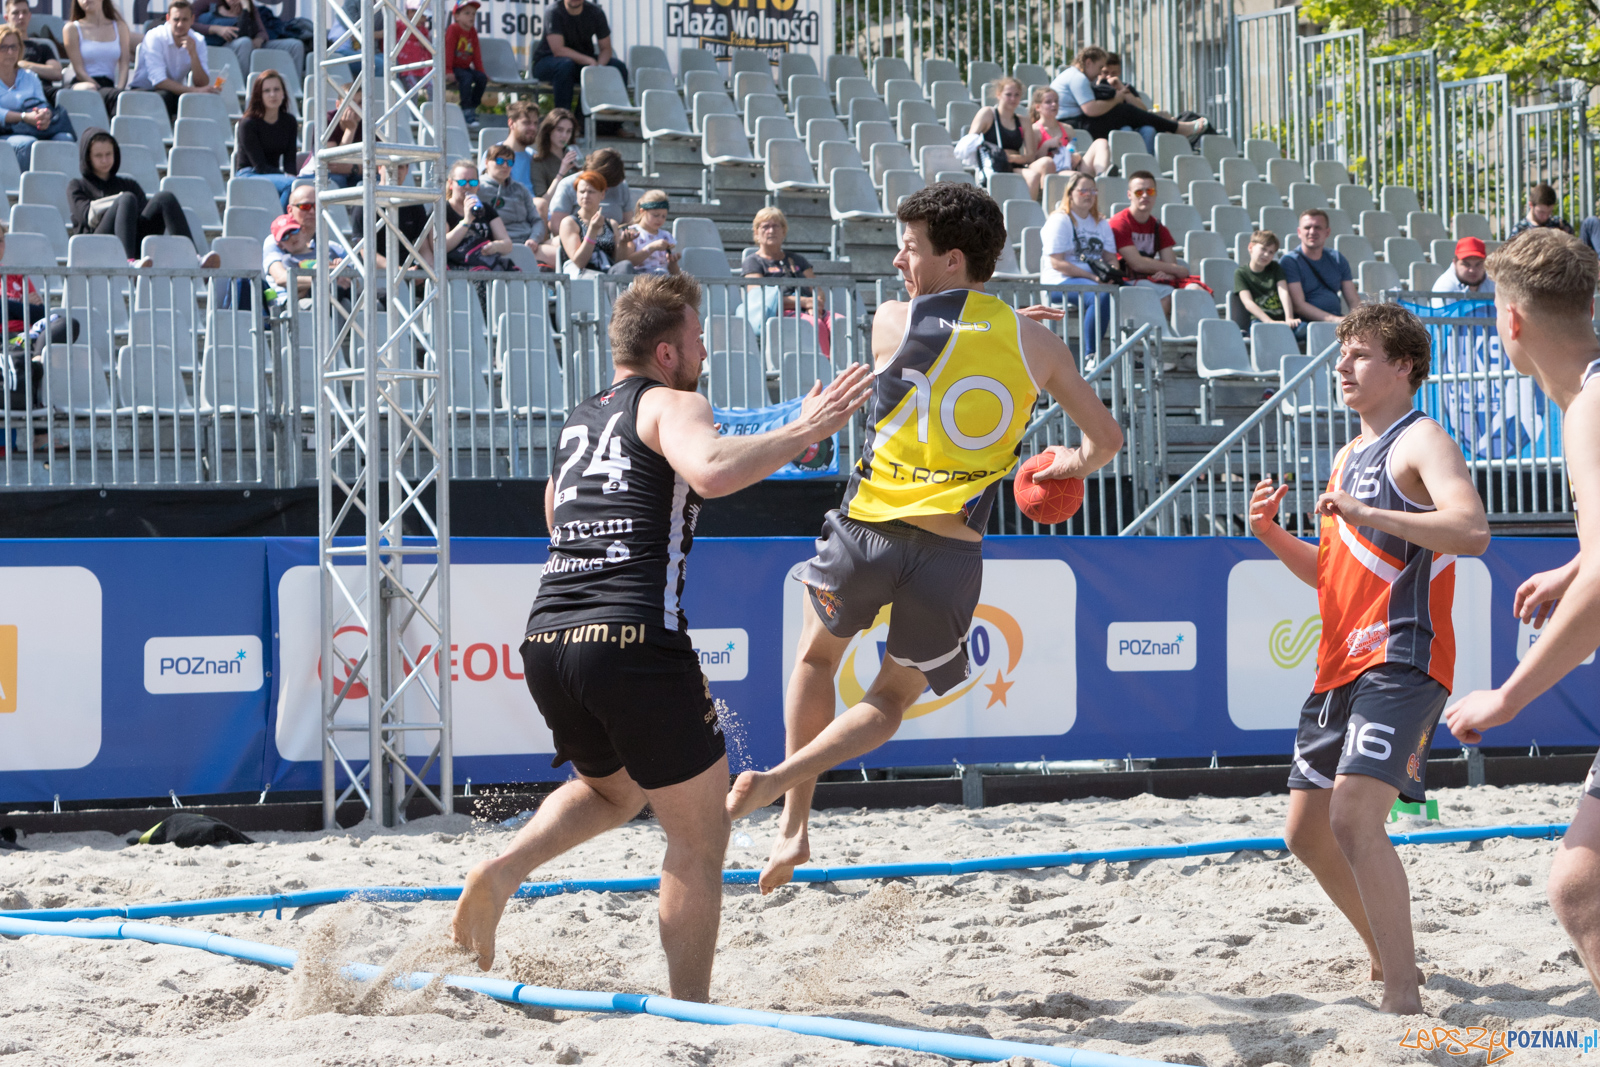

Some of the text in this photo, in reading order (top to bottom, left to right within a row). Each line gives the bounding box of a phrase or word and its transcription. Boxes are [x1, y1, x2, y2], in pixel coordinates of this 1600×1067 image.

[730, 9, 818, 43] Wolności
[939, 317, 992, 332] NED
[901, 367, 1015, 451] 10
[553, 411, 631, 511] 24
[563, 517, 633, 542] Team
[1346, 721, 1396, 761] 16
